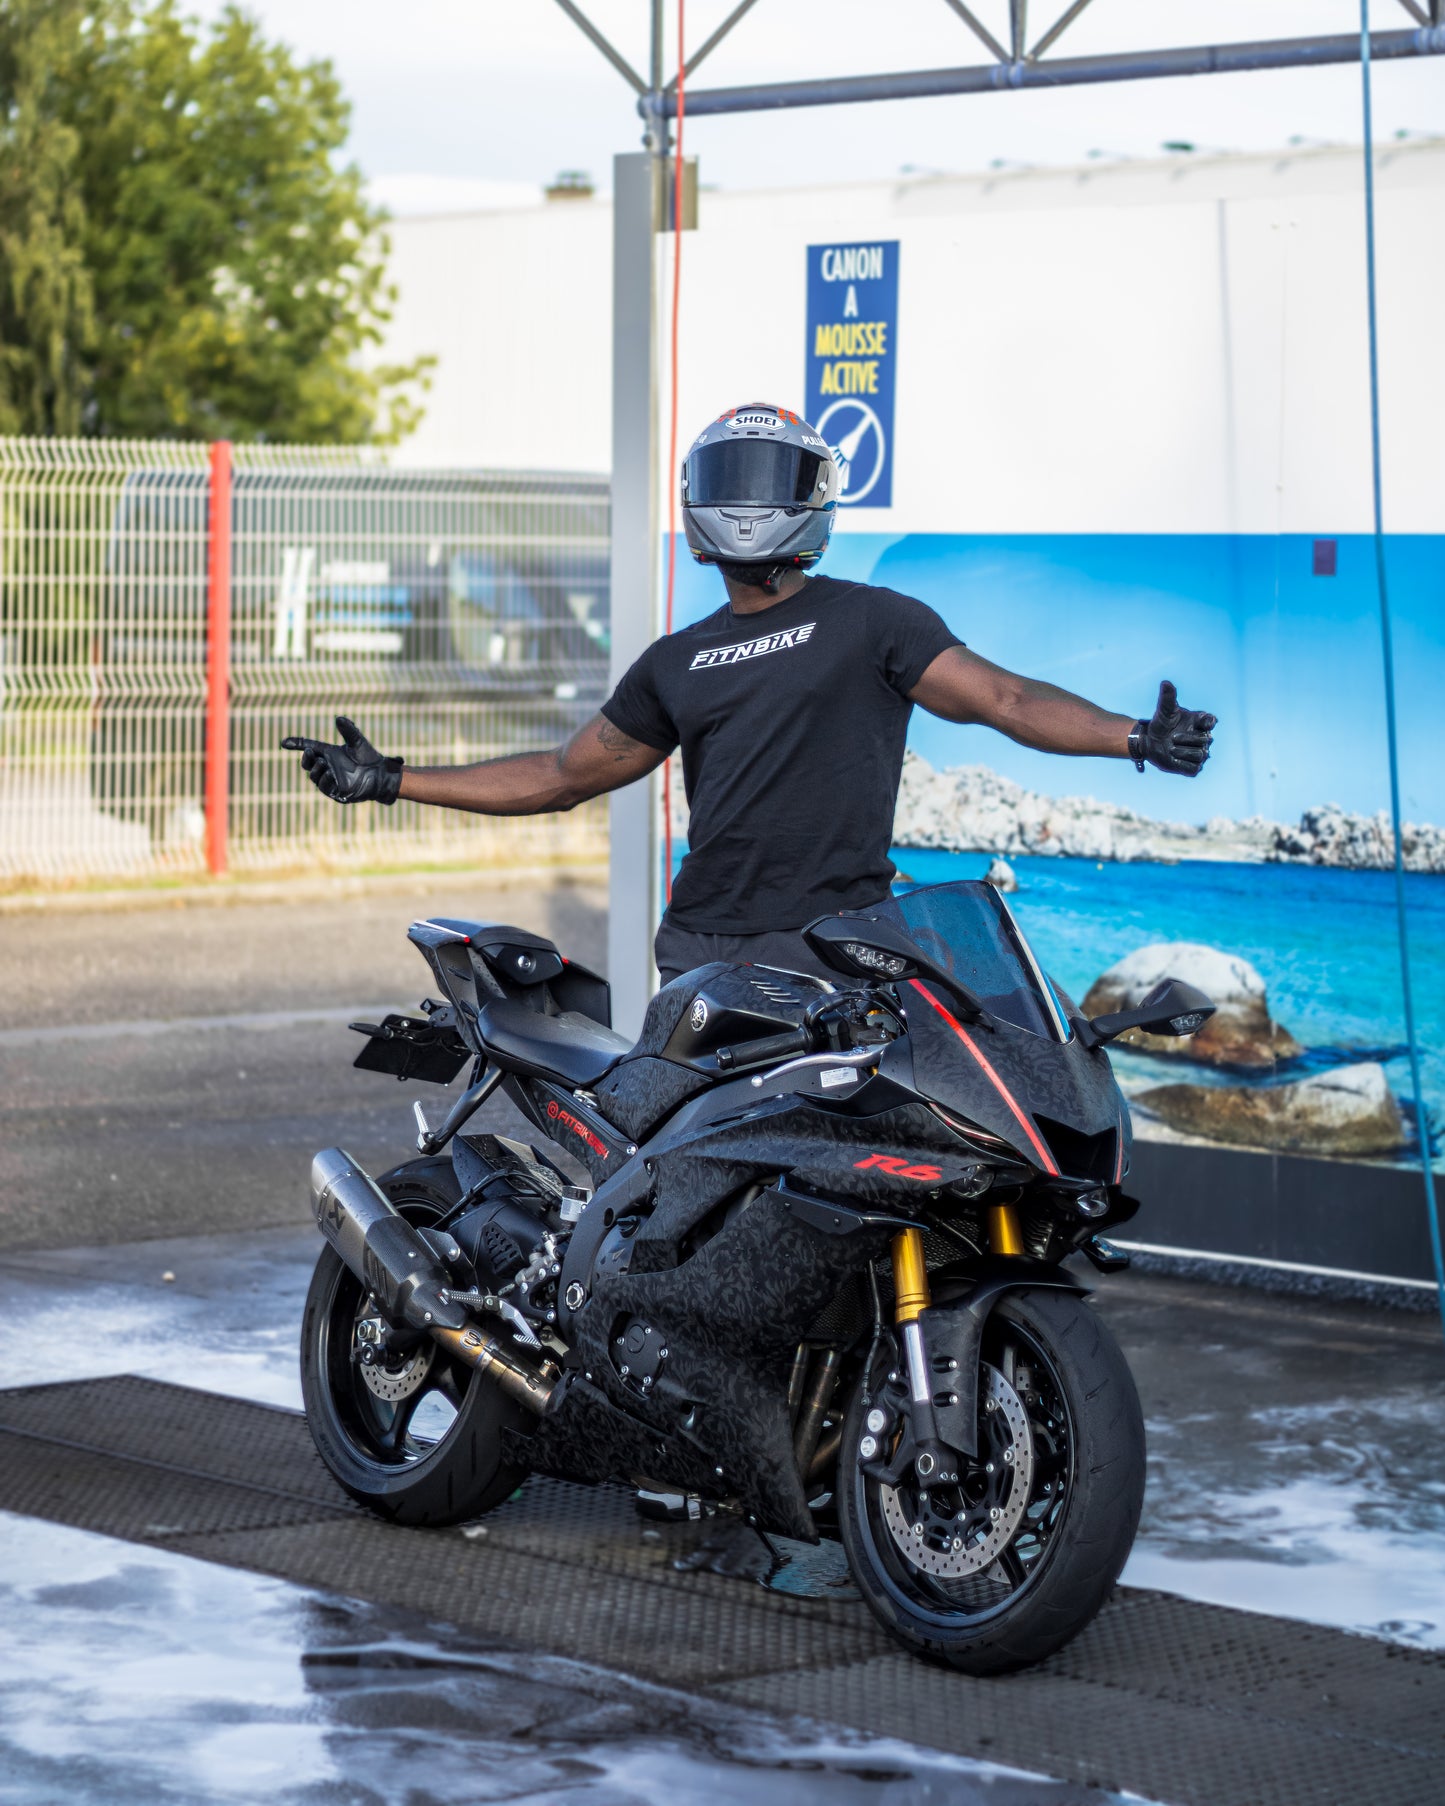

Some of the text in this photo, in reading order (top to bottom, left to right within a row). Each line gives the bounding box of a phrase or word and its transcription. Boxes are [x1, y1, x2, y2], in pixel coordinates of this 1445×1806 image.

[821, 247, 883, 282] CANON
[843, 285, 858, 318] A
[815, 322, 887, 357] MOUSSE
[820, 361, 879, 395] ACTIVE
[735, 415, 777, 427] SHOEI
[854, 1154, 943, 1181] R6
